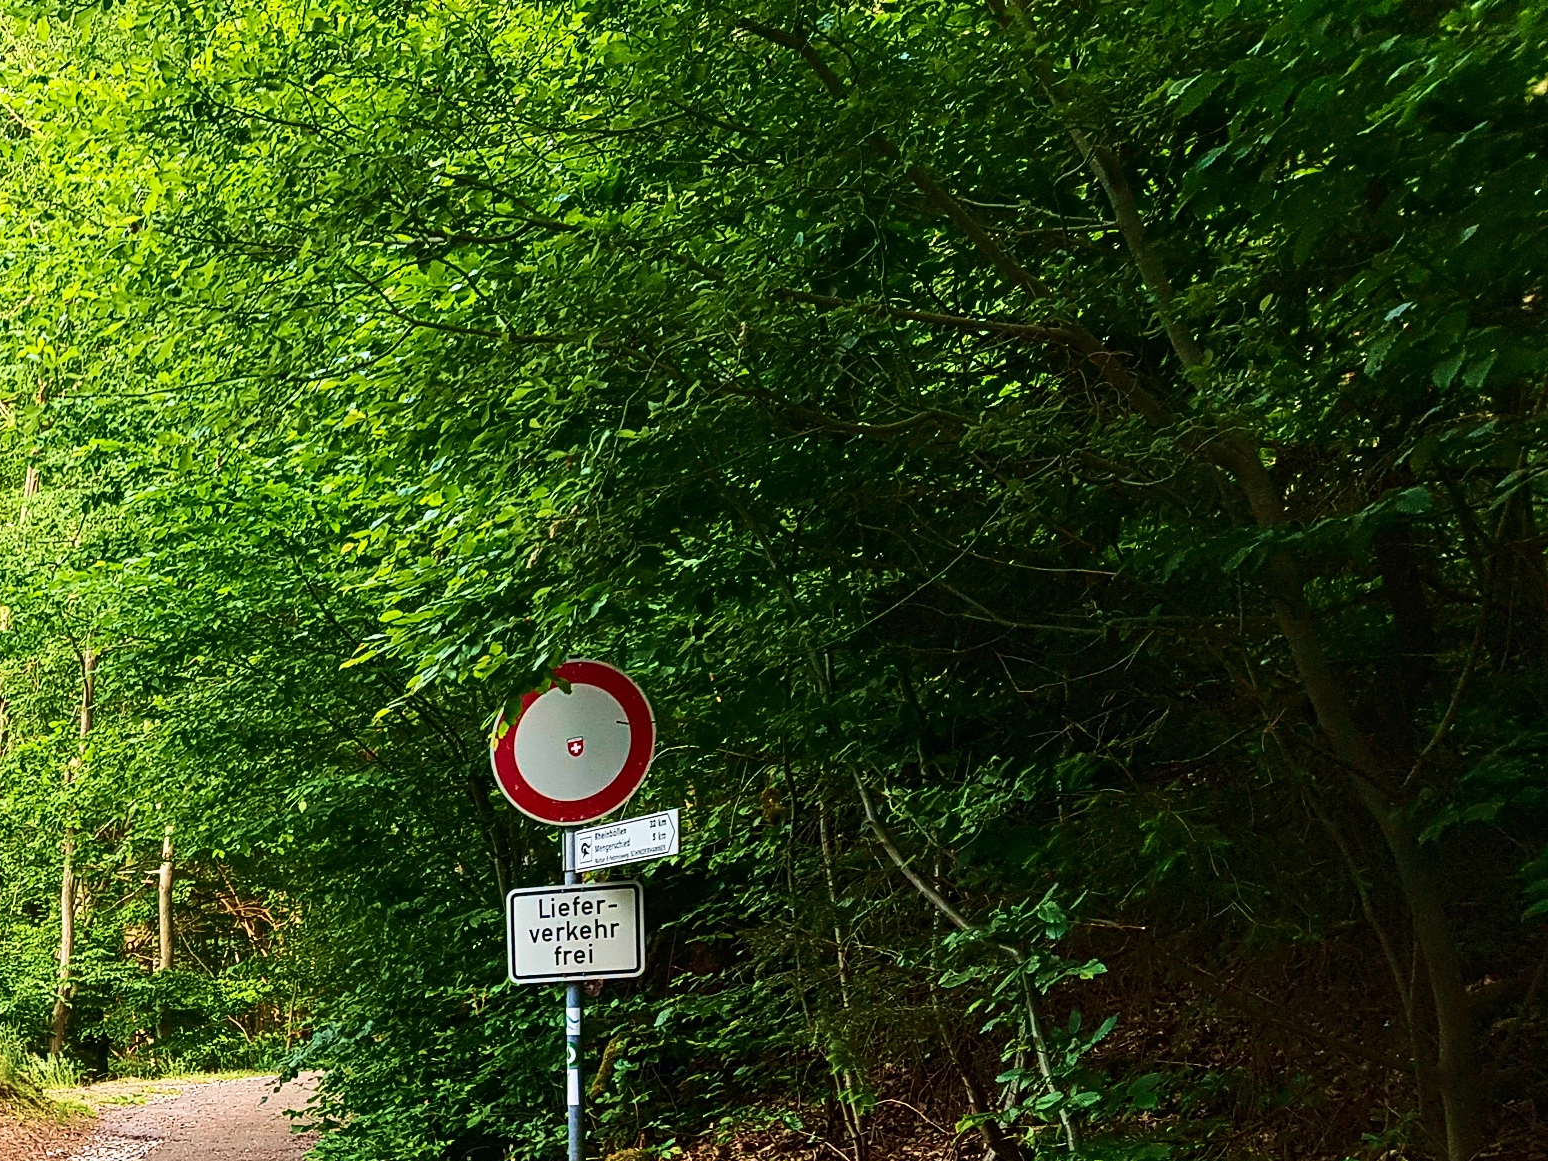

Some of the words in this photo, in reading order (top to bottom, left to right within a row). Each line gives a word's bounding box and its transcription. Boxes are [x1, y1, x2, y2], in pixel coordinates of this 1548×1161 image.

[539, 896, 618, 919] Liefer-
[529, 919, 620, 943] verkehr
[555, 944, 593, 965] frei
